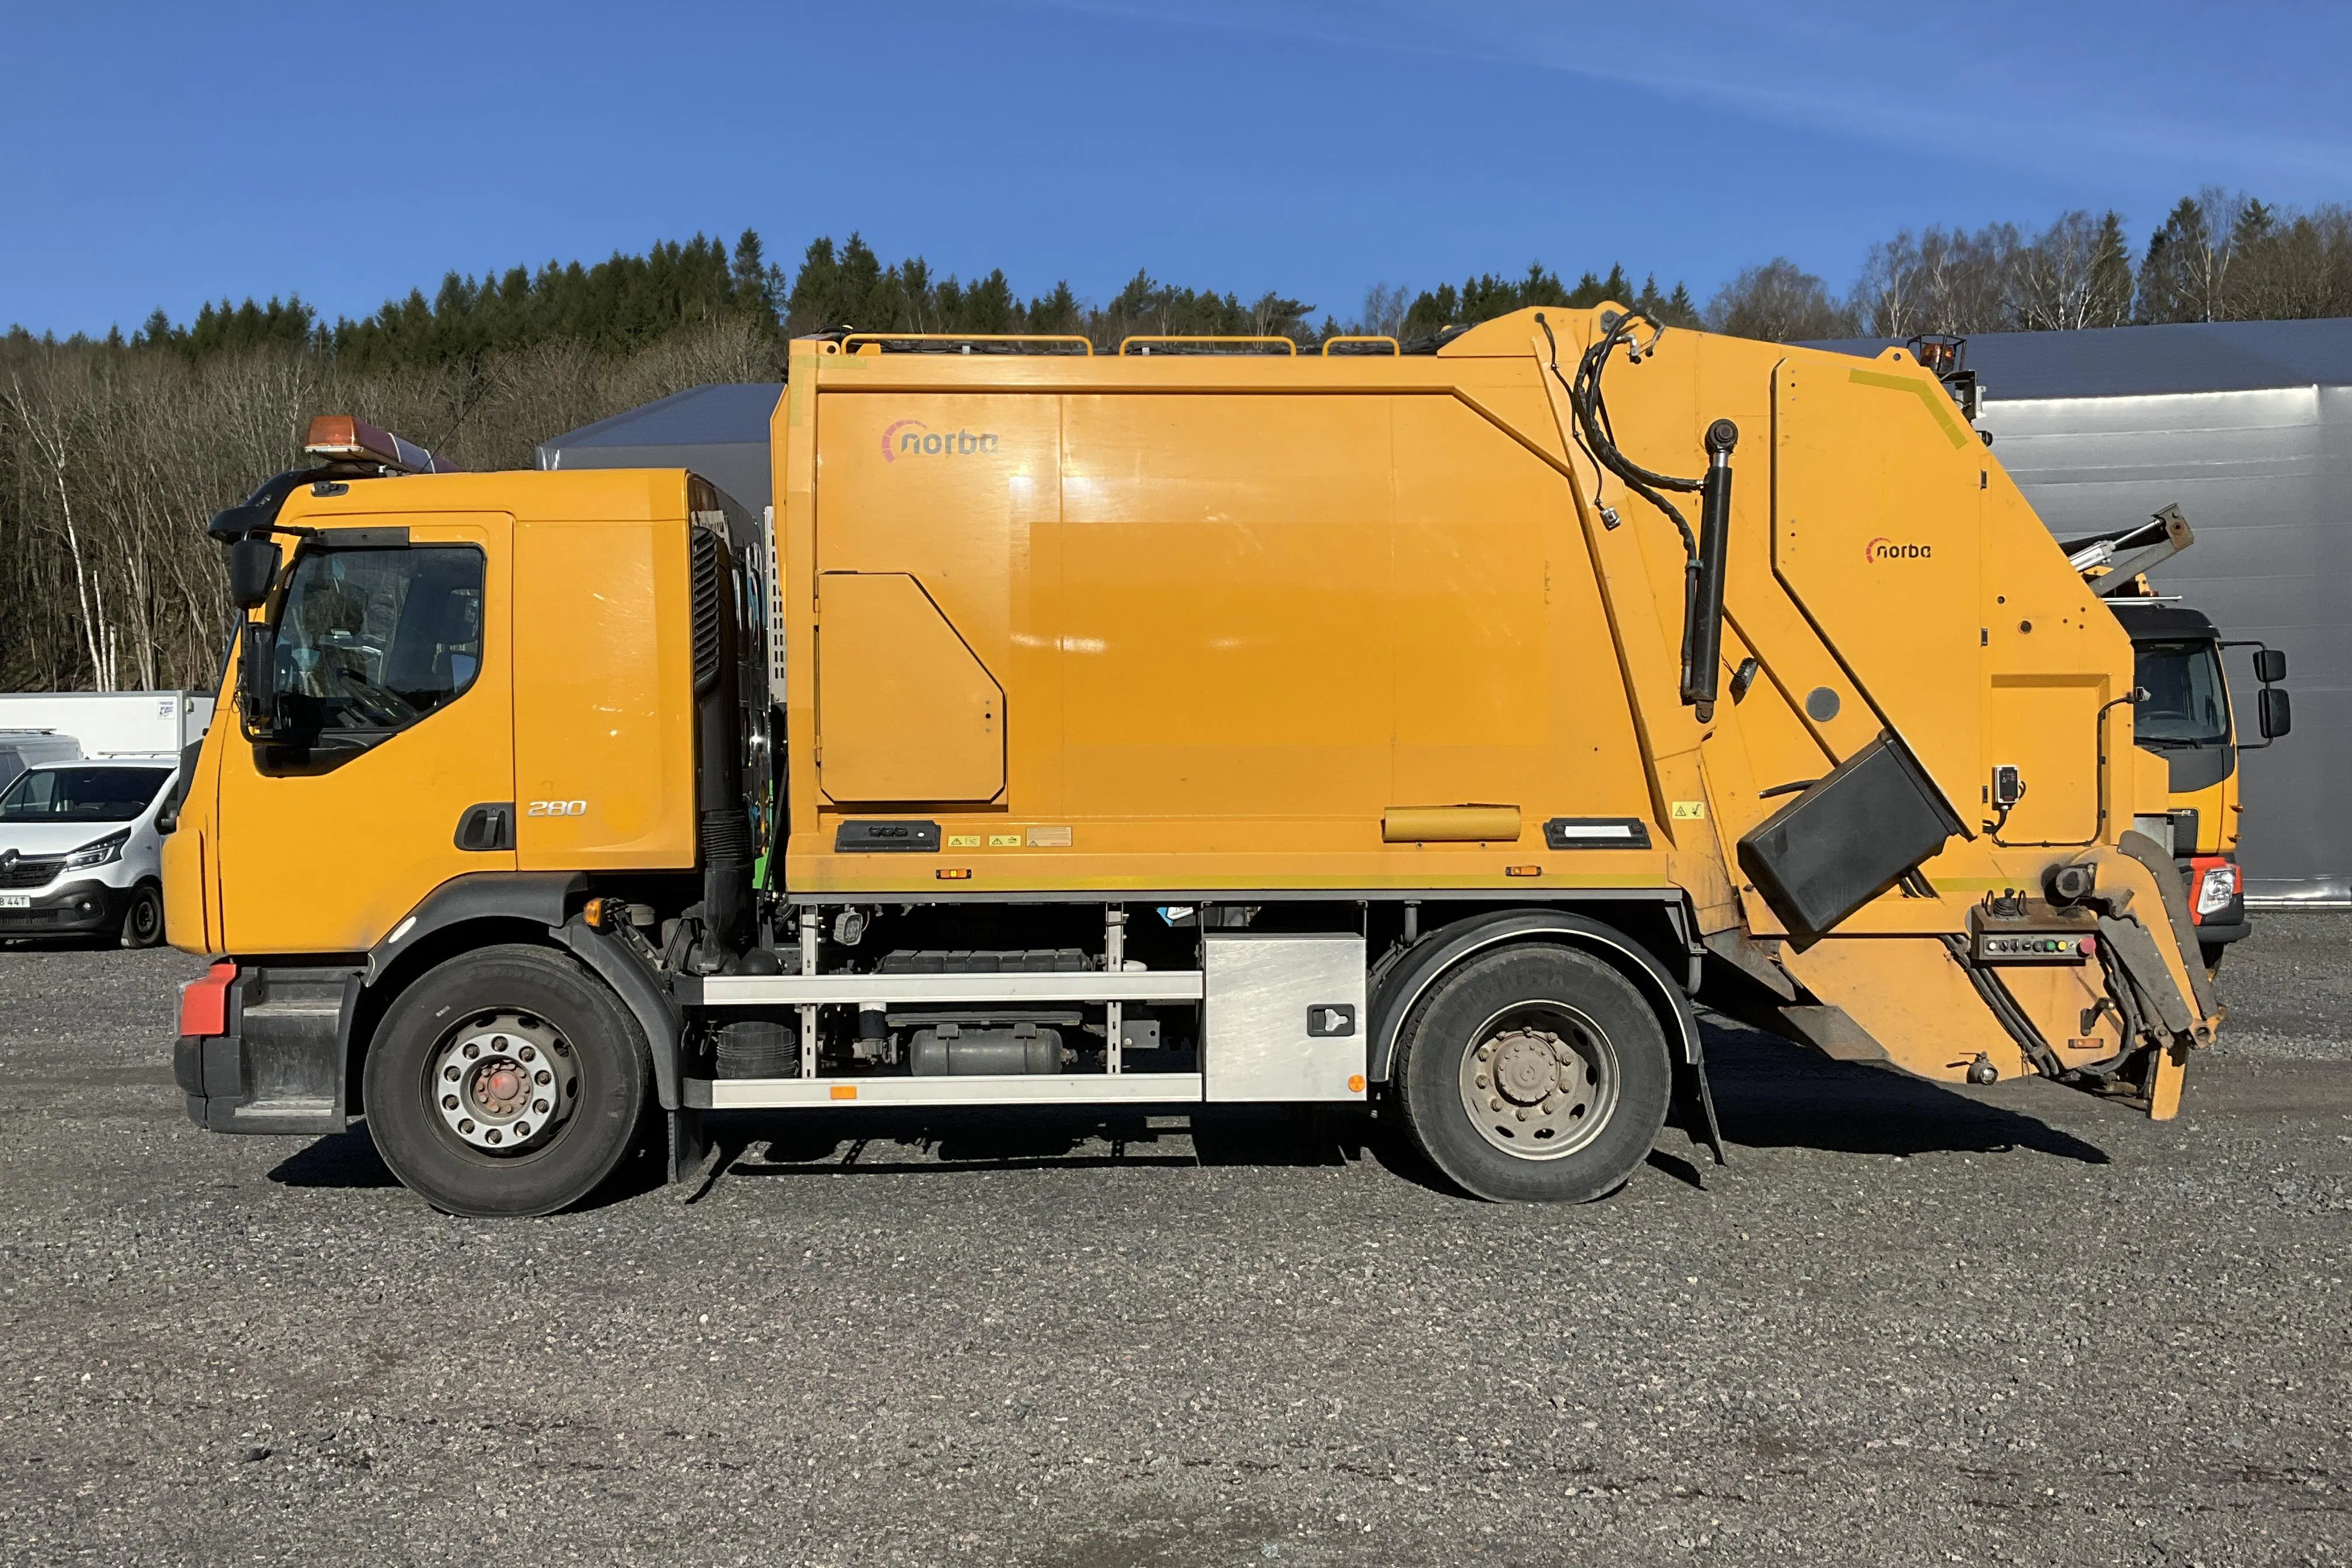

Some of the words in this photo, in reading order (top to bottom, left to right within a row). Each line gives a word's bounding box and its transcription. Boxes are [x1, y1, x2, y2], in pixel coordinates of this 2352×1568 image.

[901, 429, 999, 454] norba
[1877, 543, 1931, 558] norba
[527, 800, 587, 817] 280
[8, 897, 26, 906] 44T
